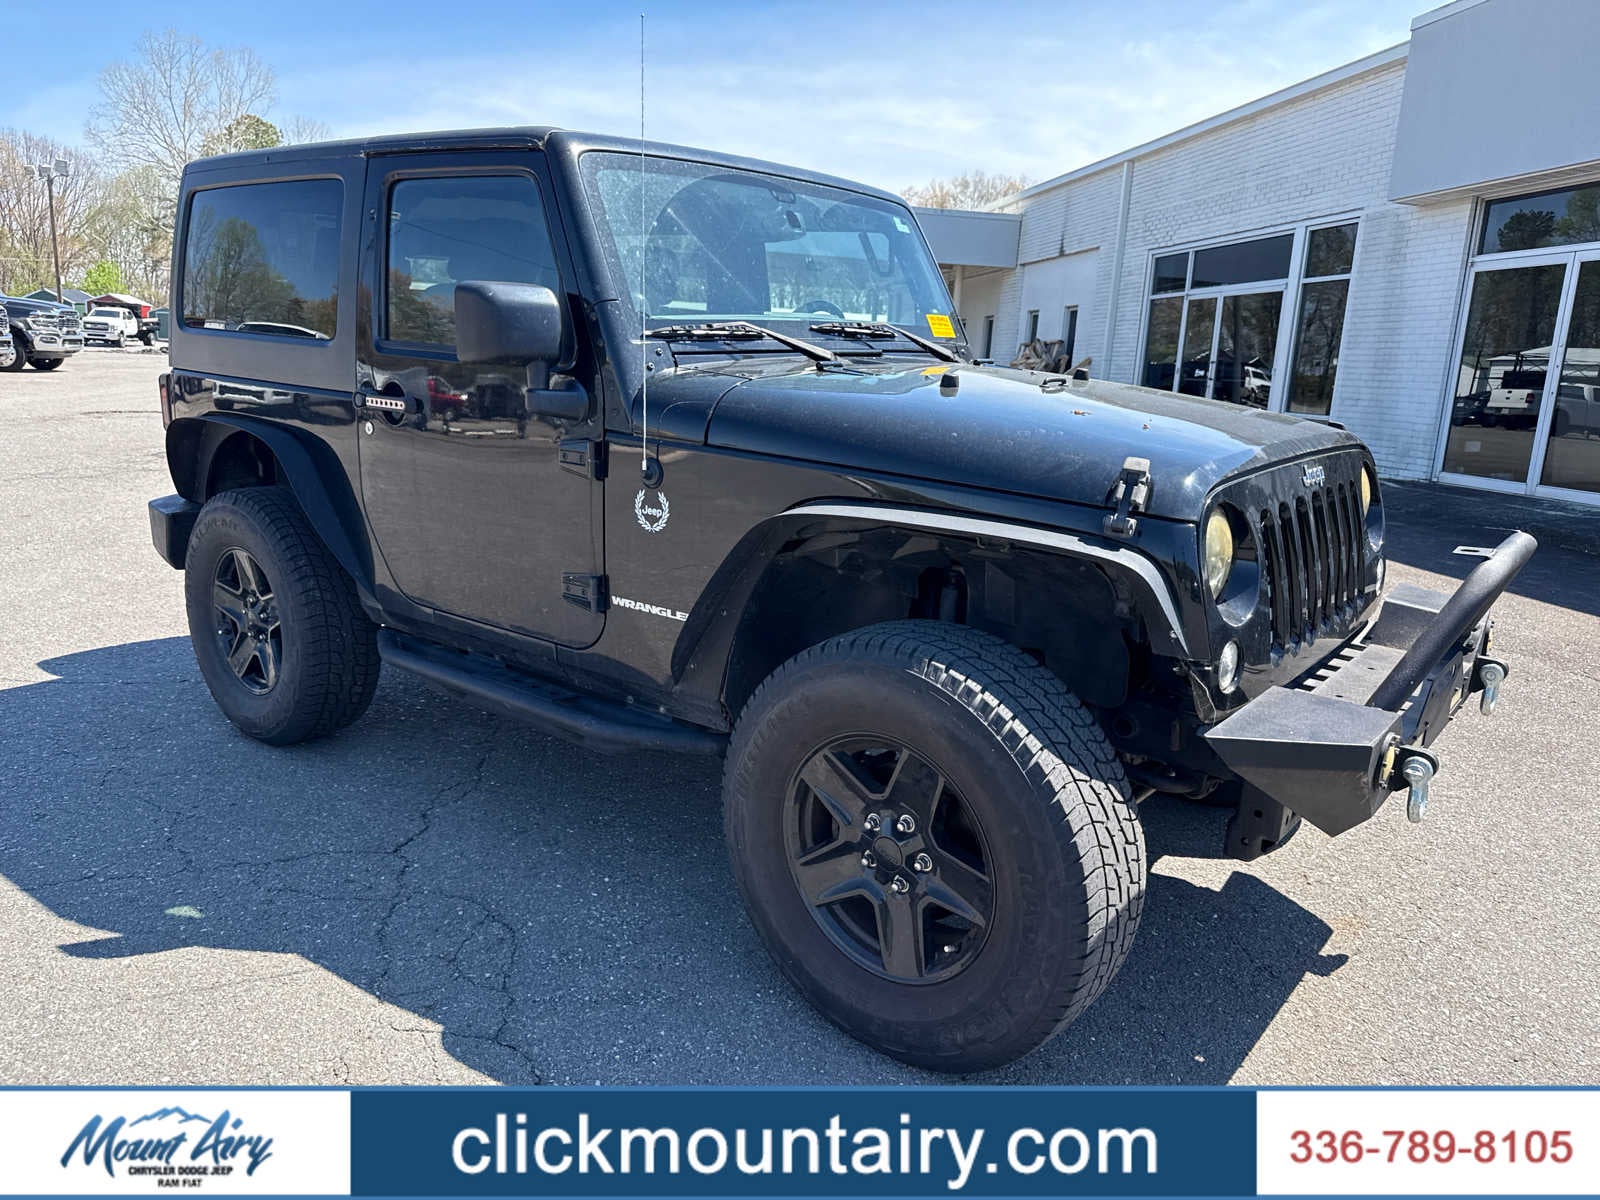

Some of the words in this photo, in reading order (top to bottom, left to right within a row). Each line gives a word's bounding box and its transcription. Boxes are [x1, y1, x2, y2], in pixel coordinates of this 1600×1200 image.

[1302, 464, 1325, 487] Jeep
[641, 505, 662, 518] Jeep
[612, 595, 689, 621] WRANGLE
